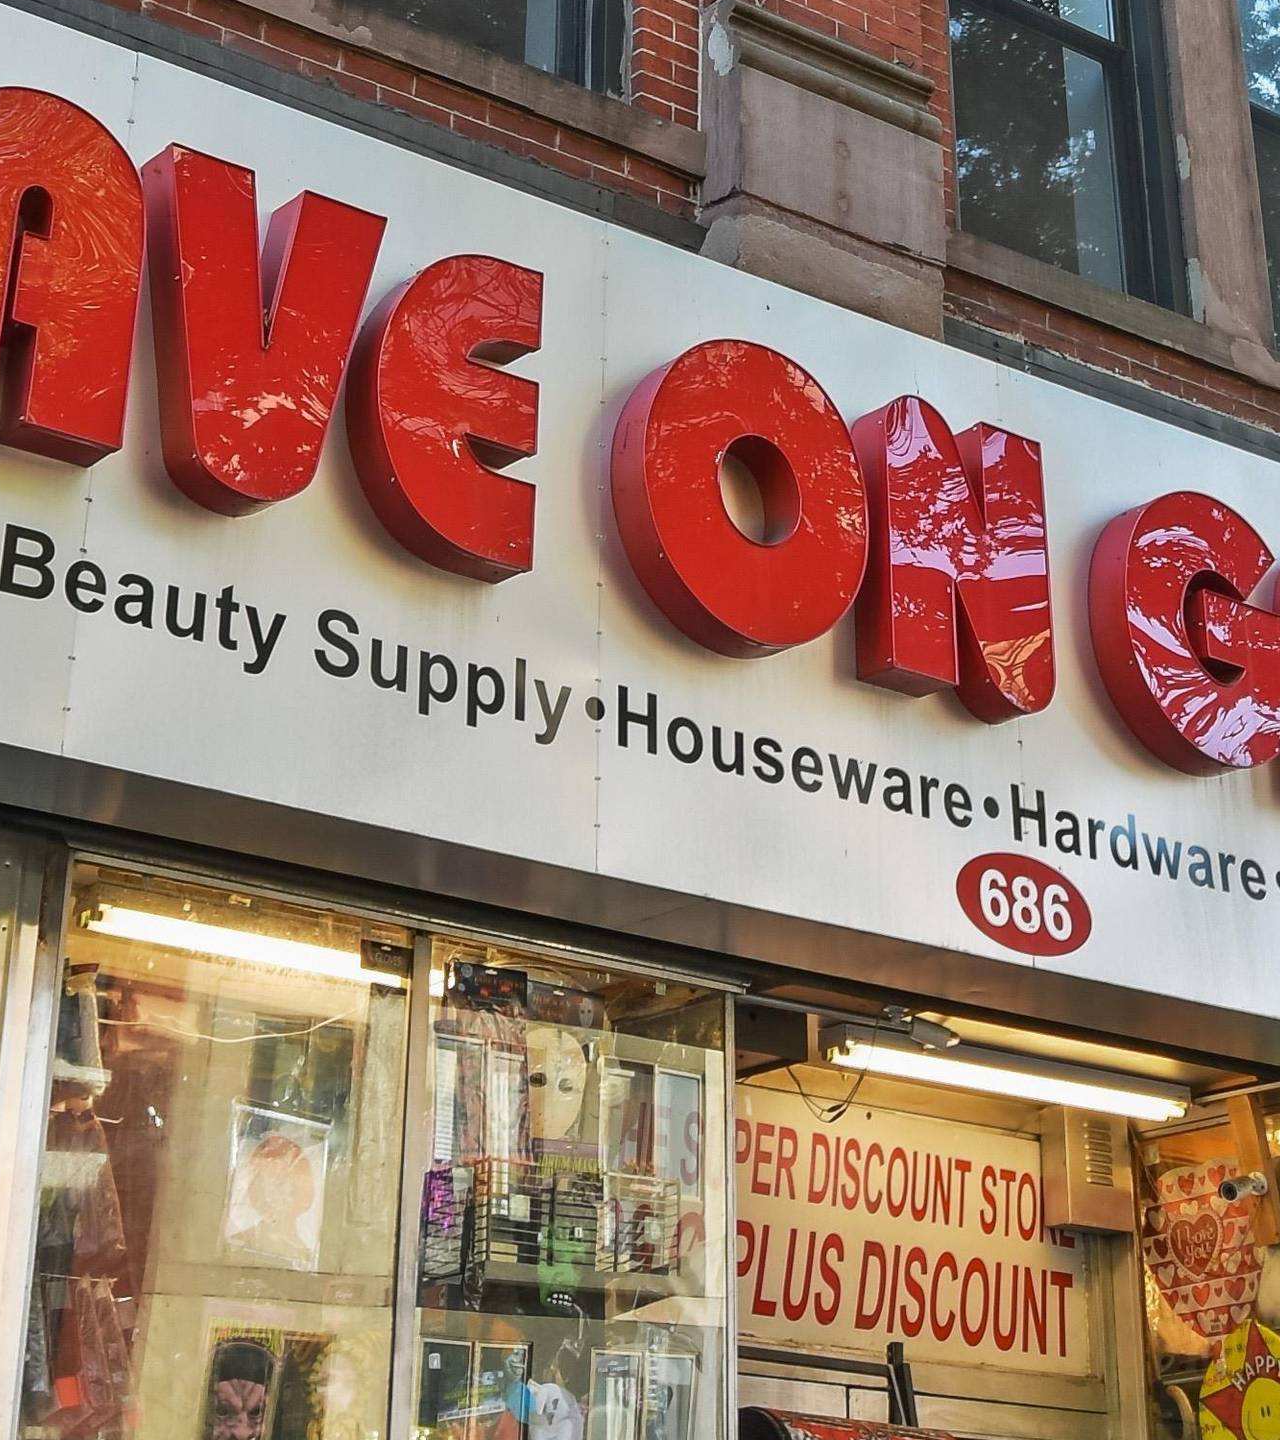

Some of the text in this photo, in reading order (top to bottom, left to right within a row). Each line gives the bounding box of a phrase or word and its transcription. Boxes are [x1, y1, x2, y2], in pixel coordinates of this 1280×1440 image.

[611, 337, 1055, 723] ON
[977, 868, 1072, 946] 686
[808, 1132, 971, 1228] DISCOUNT
[854, 1240, 1073, 1358] DISCOUNT
